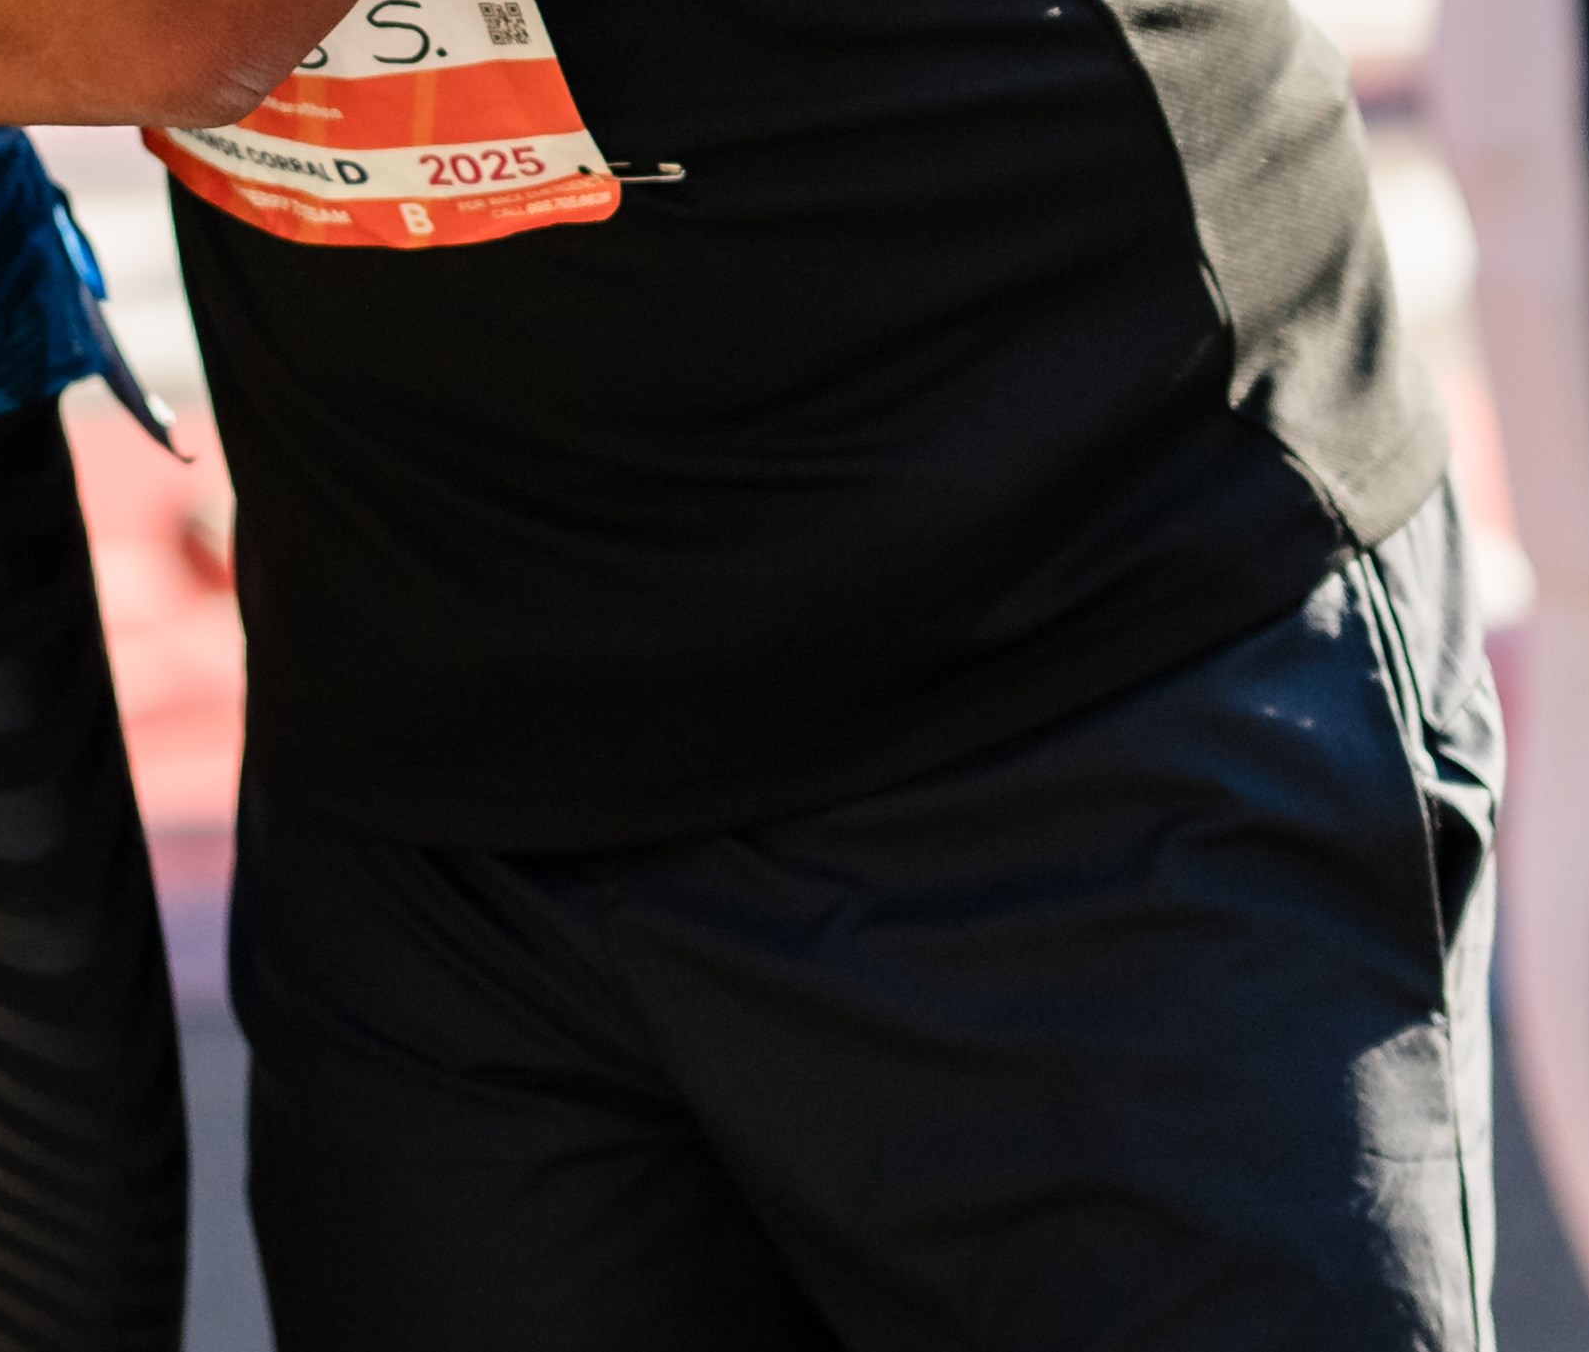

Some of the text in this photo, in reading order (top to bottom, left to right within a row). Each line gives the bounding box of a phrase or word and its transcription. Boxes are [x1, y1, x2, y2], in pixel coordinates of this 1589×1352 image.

[333, 158, 369, 185] D
[418, 145, 546, 186] 2025
[398, 202, 436, 235] B
